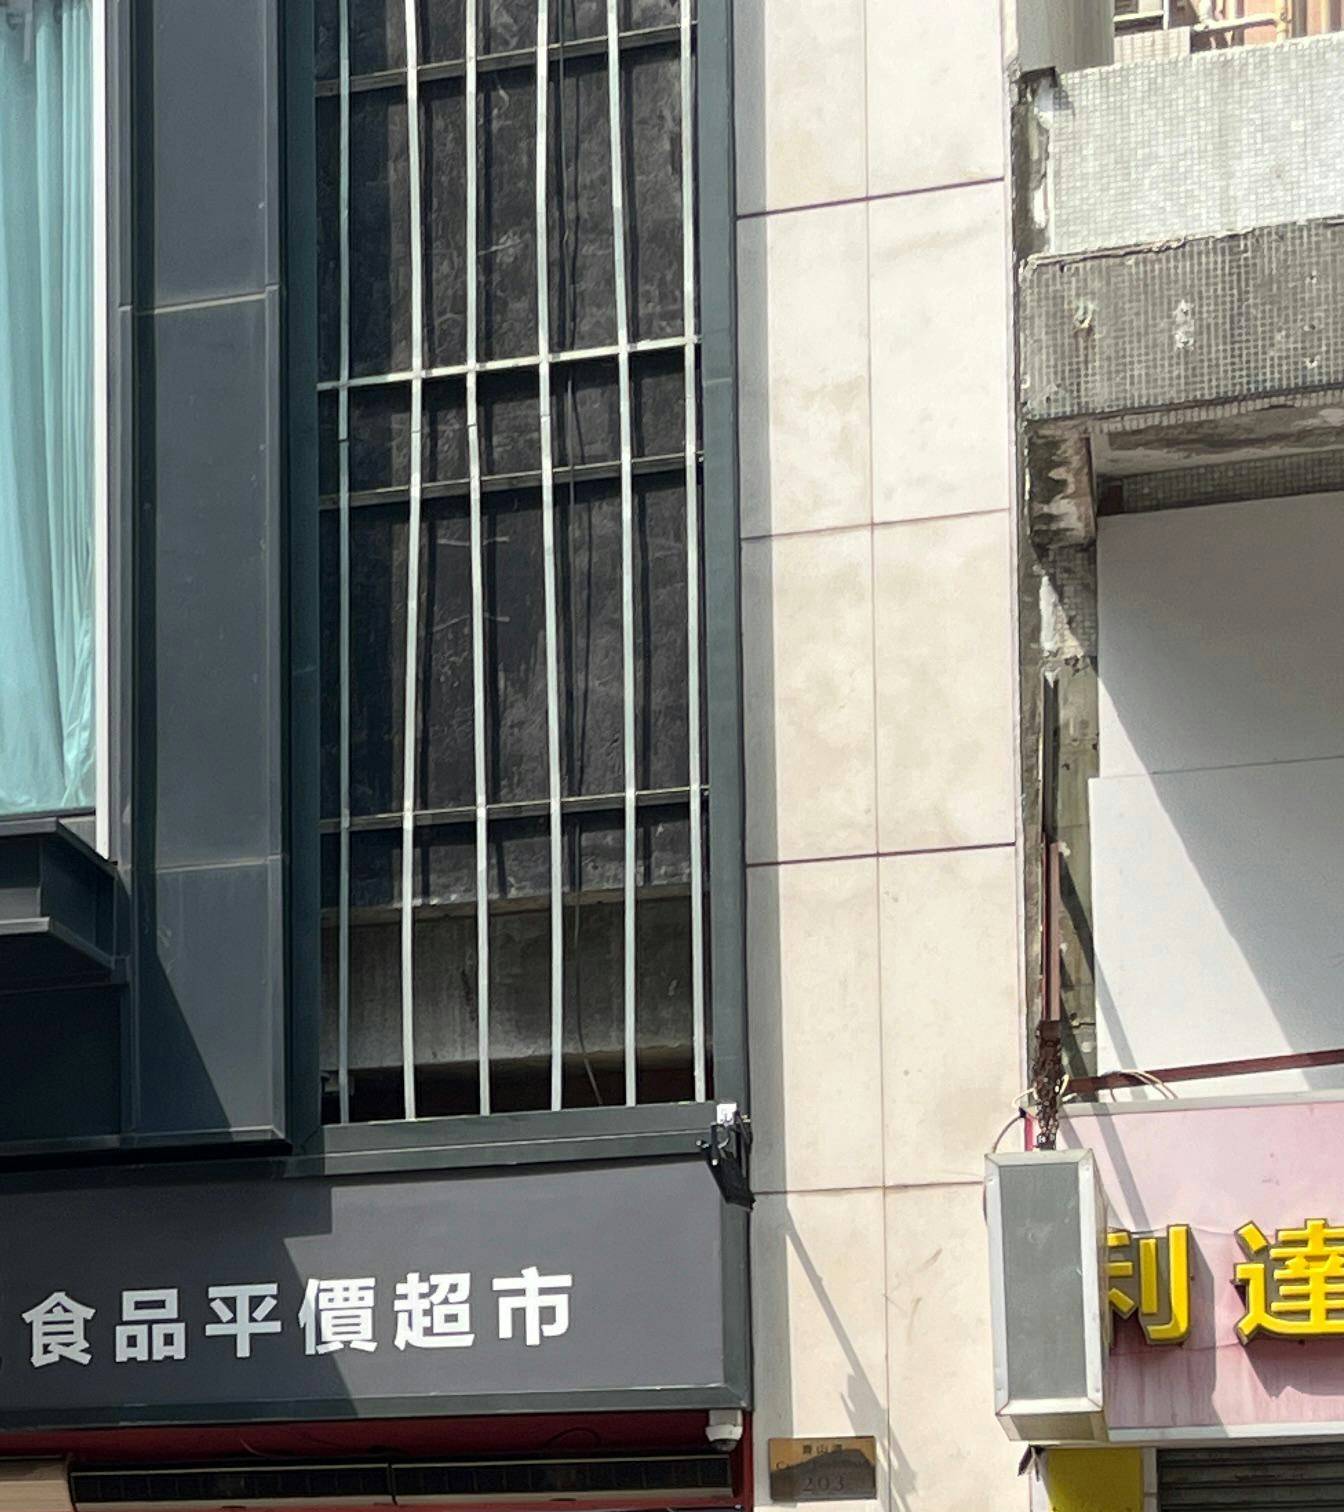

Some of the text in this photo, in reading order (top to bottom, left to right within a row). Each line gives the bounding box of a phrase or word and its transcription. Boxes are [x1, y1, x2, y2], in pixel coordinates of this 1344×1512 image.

[22, 1267, 575, 1368] 食品平價超市
